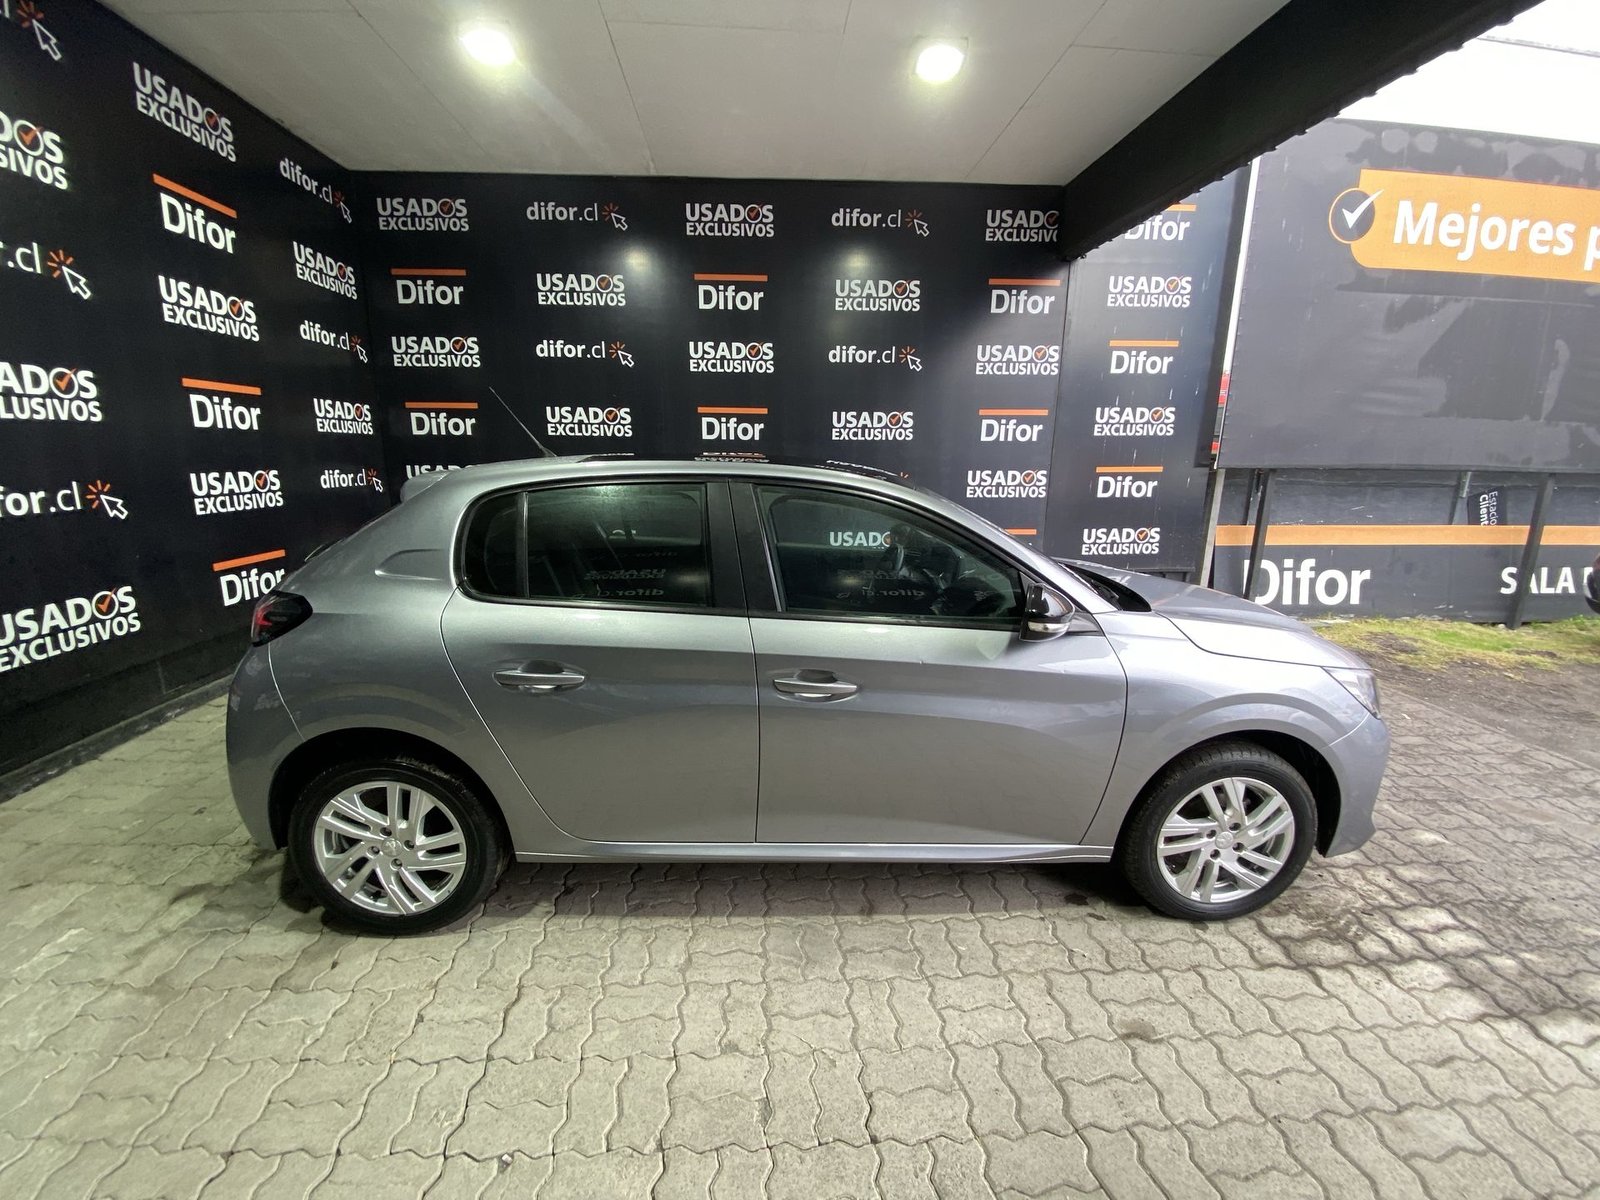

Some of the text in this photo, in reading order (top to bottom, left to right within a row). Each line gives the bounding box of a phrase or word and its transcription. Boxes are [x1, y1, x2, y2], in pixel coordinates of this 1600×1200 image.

[133, 62, 233, 142] USADOS
[136, 91, 236, 162] EXCLUSIVOS
[280, 158, 332, 203] difor.cl
[377, 198, 467, 217] USADOS
[527, 202, 597, 220] difor.cl
[686, 204, 773, 223] USADOS
[160, 193, 235, 253] Difor
[379, 217, 469, 231] EXCLUSIVOS
[832, 208, 901, 227] difor.cl
[986, 209, 1059, 229] USADO
[687, 223, 774, 237] EXCLUSIVOS
[985, 228, 1058, 242] EXCLUSIV
[1393, 200, 1576, 261] Mejores
[293, 242, 355, 284] USADOS
[296, 263, 357, 299] EXCLUSIVOS
[537, 273, 624, 292] USADOS
[836, 279, 920, 298] USADOS
[1109, 276, 1191, 294] USADOS
[158, 275, 256, 323] USADOS
[397, 280, 463, 304] Difor
[538, 292, 626, 306] EXCLUSIVOS
[699, 285, 763, 310] Difor
[1107, 294, 1190, 307] EXCLUSIVOS
[836, 298, 920, 311] EXCLUSIVOS
[991, 290, 1055, 314] Difor
[163, 303, 259, 341] EXCLUSIVOS
[300, 320, 349, 350] difor.cl
[392, 337, 478, 354] USADOS
[536, 340, 605, 358] difor.cl
[690, 342, 773, 360] USADOS
[829, 346, 895, 363] difor.cl
[977, 345, 1059, 363] USADOS
[394, 355, 480, 367] EXCLUSIVOS
[690, 360, 774, 373] EXCLUSIVOS
[976, 363, 1058, 375] EXCLUSIVOS
[1111, 351, 1173, 374] Difor
[190, 394, 260, 430] Difor
[314, 398, 371, 421] USADOS
[546, 407, 631, 424] USADOS
[1096, 406, 1175, 424] USADOS
[316, 418, 373, 434] EXCLUSIVOS
[411, 413, 475, 435] Difor
[702, 417, 764, 440] Difor
[833, 412, 913, 428] USADOS
[548, 424, 632, 437] EXCLUSIVOS
[832, 429, 913, 440] EXCLUSIVOS
[981, 419, 1043, 441] Difor
[1094, 424, 1174, 436] EXCLUSIVOS
[190, 470, 280, 496] USADOS
[321, 469, 366, 488] difor.cl
[968, 470, 1047, 486] USADOS
[1097, 476, 1157, 497] Difor
[967, 487, 1046, 497] EXCLUSIVOS
[194, 492, 283, 515] EXCLUSIVOS
[829, 531, 890, 547] USADO
[1083, 527, 1160, 544] USADOS
[1082, 543, 1159, 555] EXCLUSIVOS
[220, 569, 284, 606] Difor
[0, 613, 140, 672] EXCLUSIVOS
